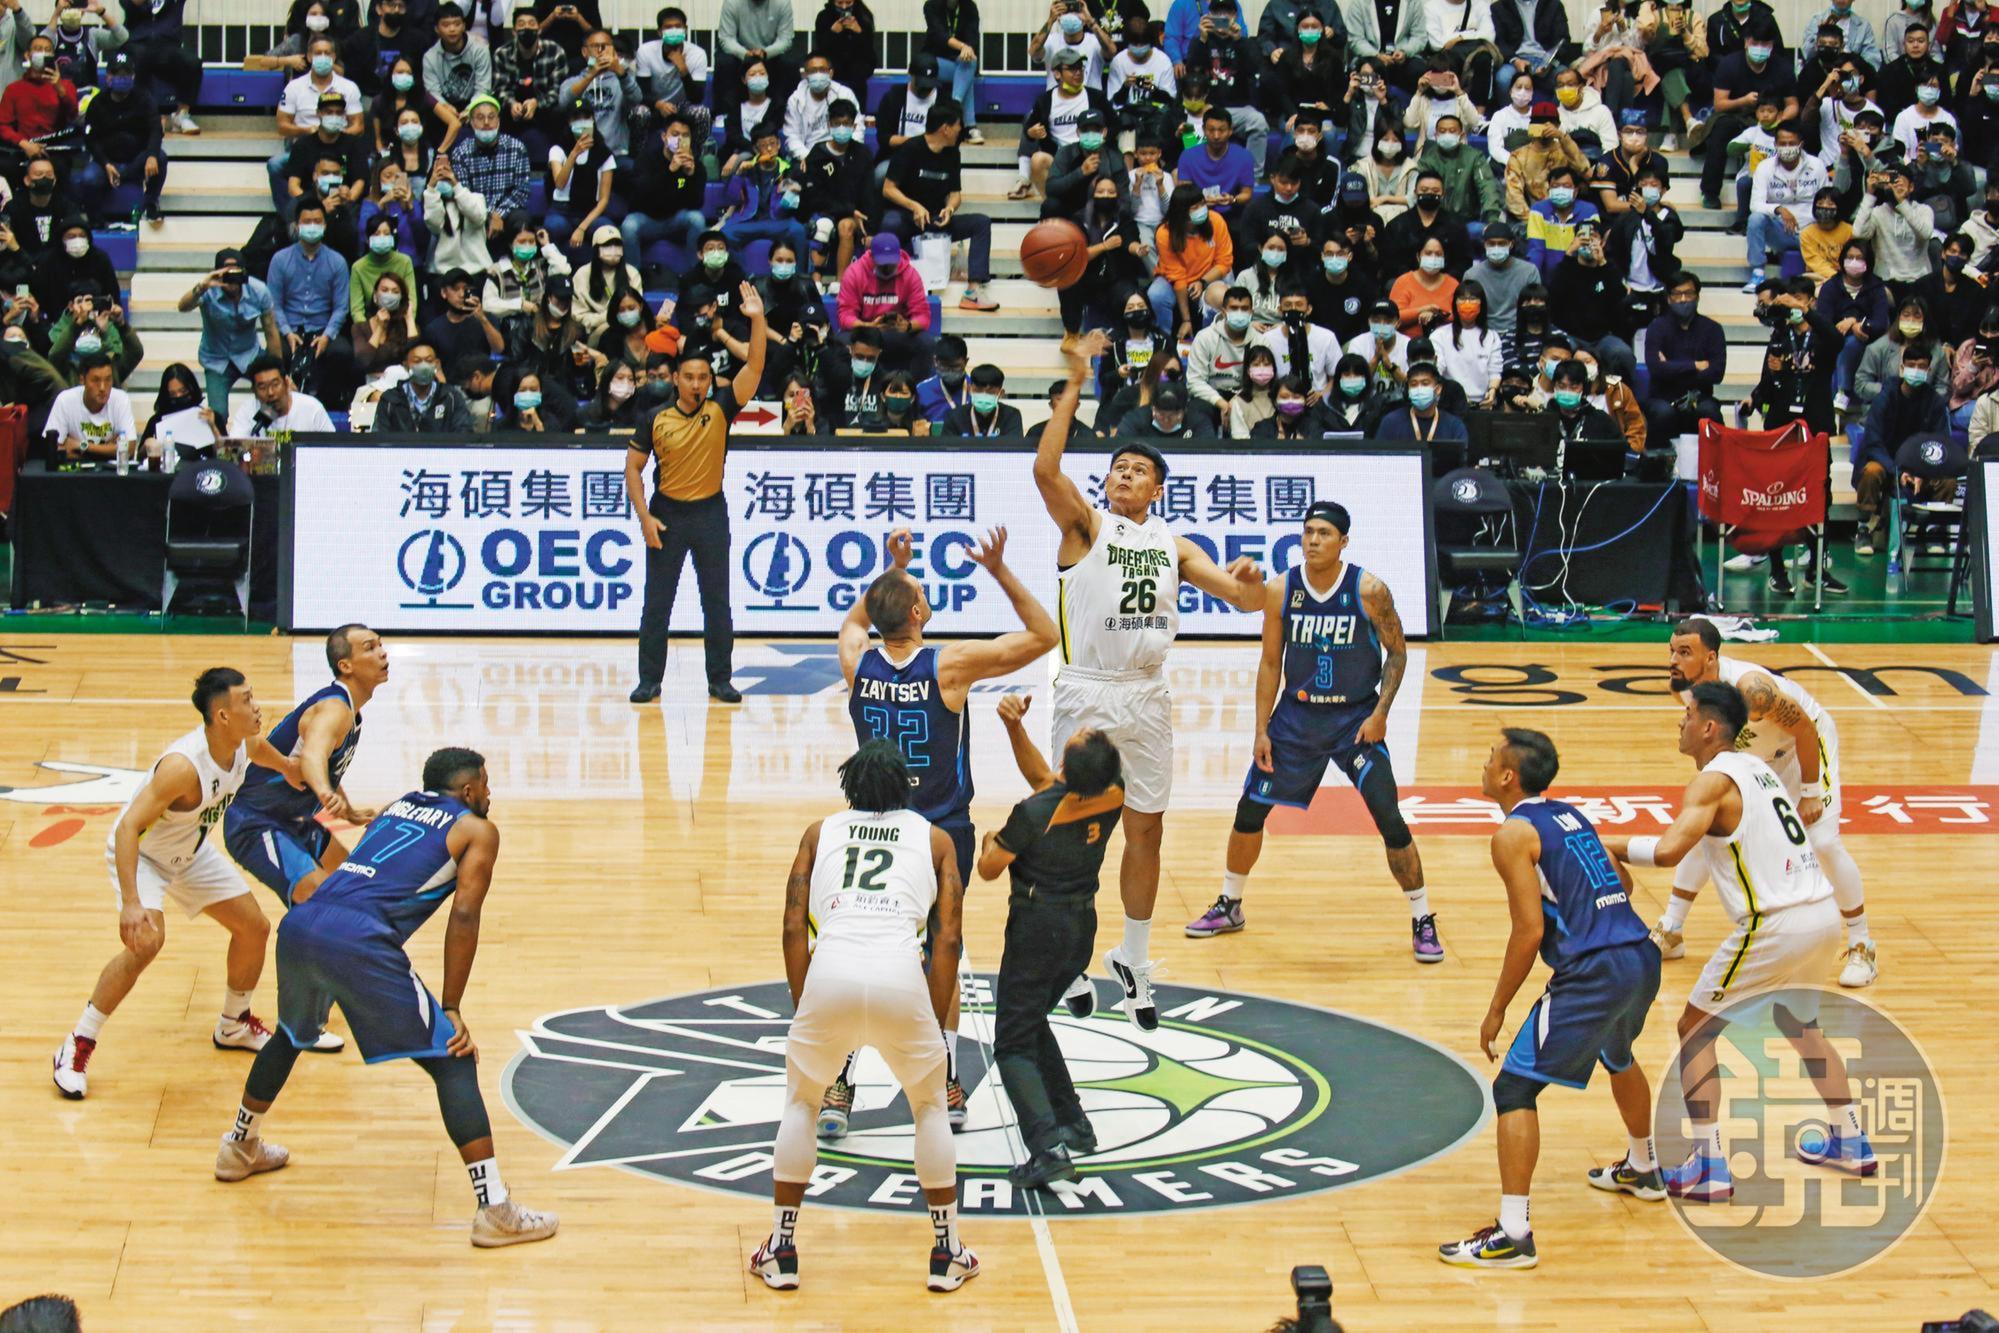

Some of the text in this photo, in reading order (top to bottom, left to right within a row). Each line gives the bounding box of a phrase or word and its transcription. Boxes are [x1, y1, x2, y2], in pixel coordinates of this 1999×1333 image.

[400, 469, 632, 520] 海碩集團
[744, 471, 976, 522] 海碩集團
[1740, 487, 1806, 507] SPALDING
[481, 528, 633, 577] OEC
[826, 531, 977, 580] OEC
[482, 581, 633, 609] GROUP
[827, 583, 977, 611] GUP
[1119, 578, 1157, 614] 26
[1290, 614, 1356, 645] TAIPEI
[1315, 655, 1333, 689] 3
[860, 678, 929, 702] ZAYTSEV
[1397, 795, 1990, 825] 台新行
[1772, 796, 1806, 846] 6
[849, 825, 900, 842] YOUNG
[1087, 822, 1100, 844] 3
[842, 846, 894, 891] 12
[1564, 832, 1620, 889] 12
